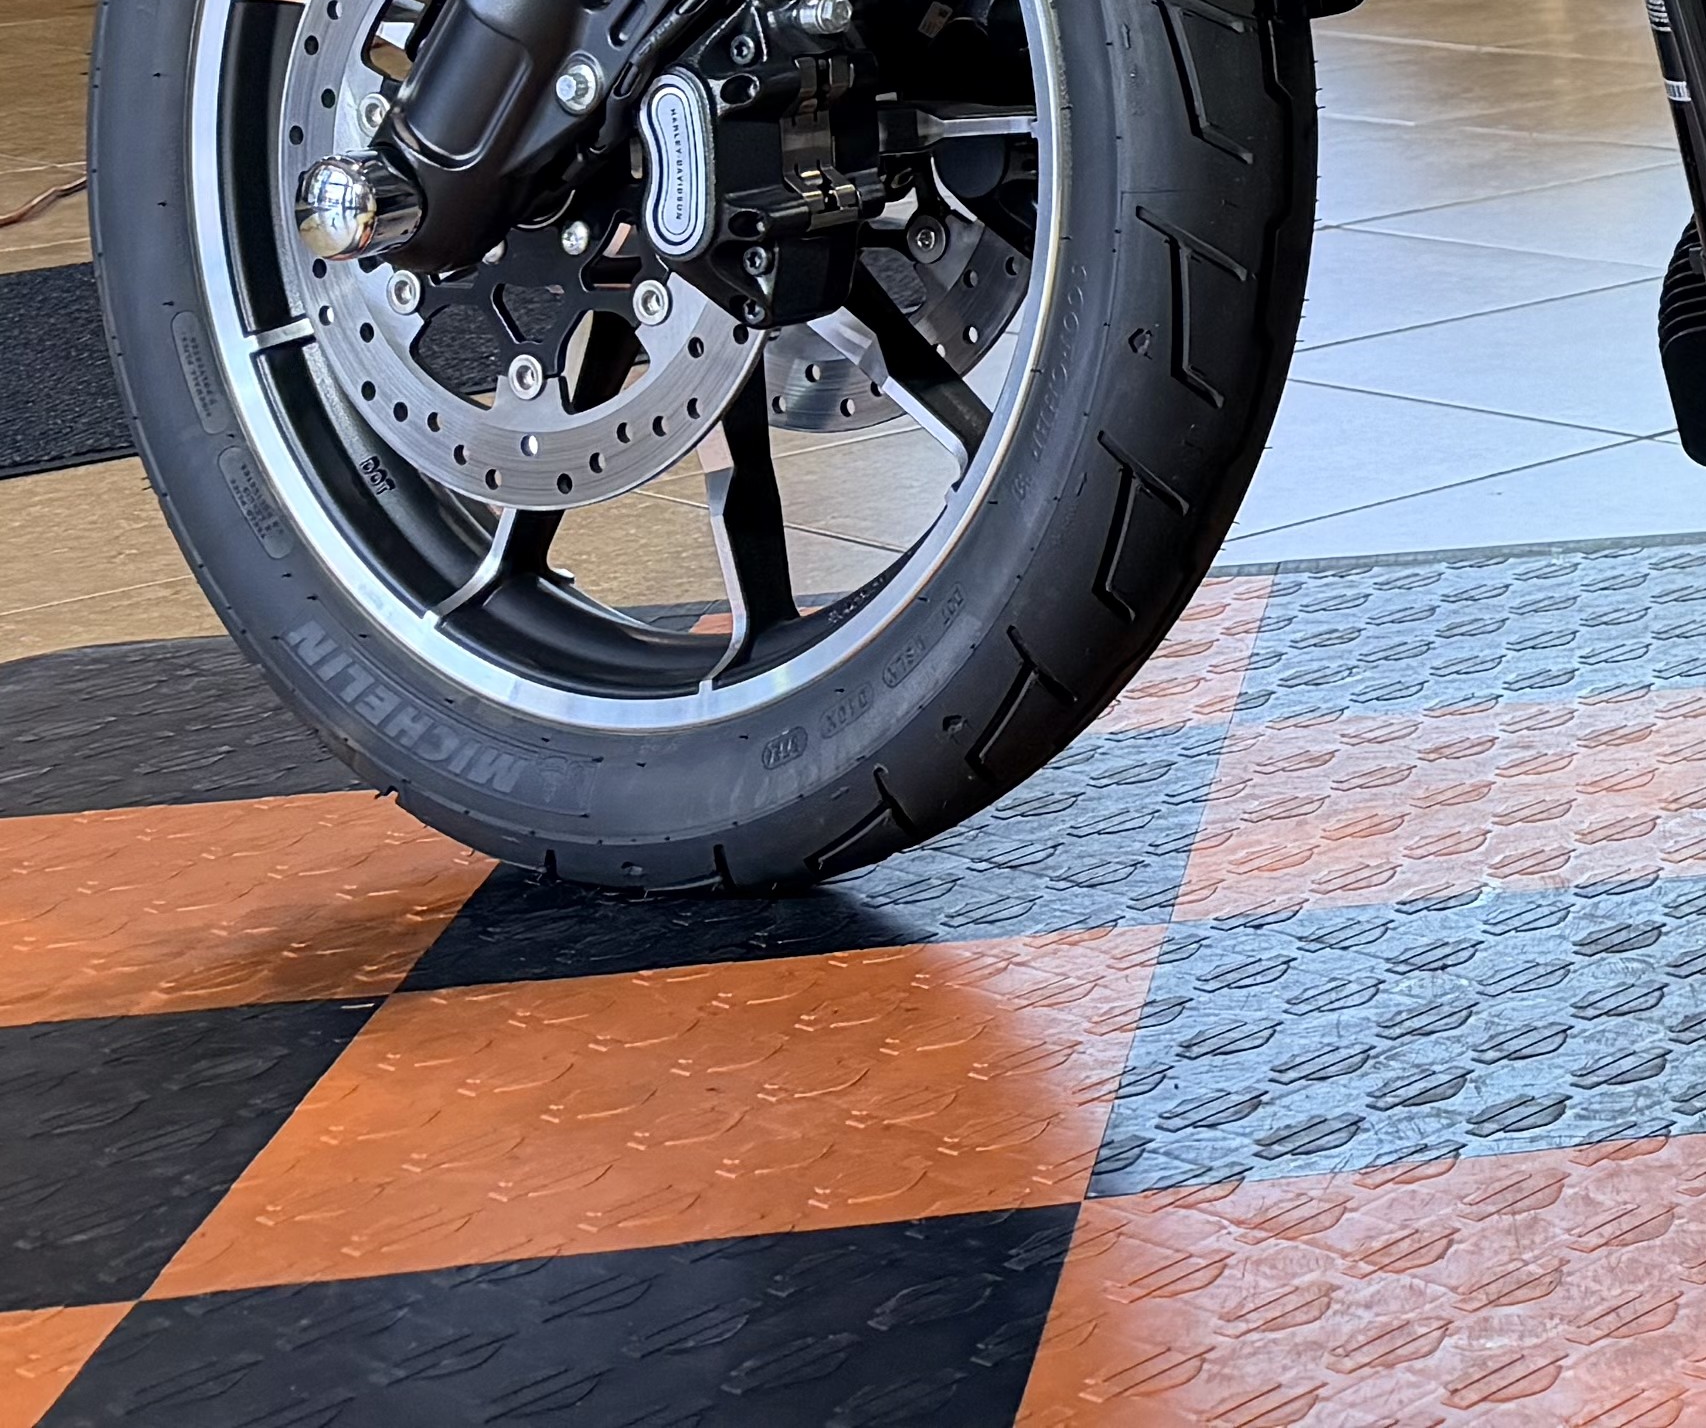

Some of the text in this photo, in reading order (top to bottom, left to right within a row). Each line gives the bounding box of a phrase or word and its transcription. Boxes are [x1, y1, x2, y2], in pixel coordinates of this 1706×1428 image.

[669, 107, 683, 221] HARLEY-DAVIDSON
[360, 455, 397, 495] DOT
[289, 618, 530, 795] MICHELIN
